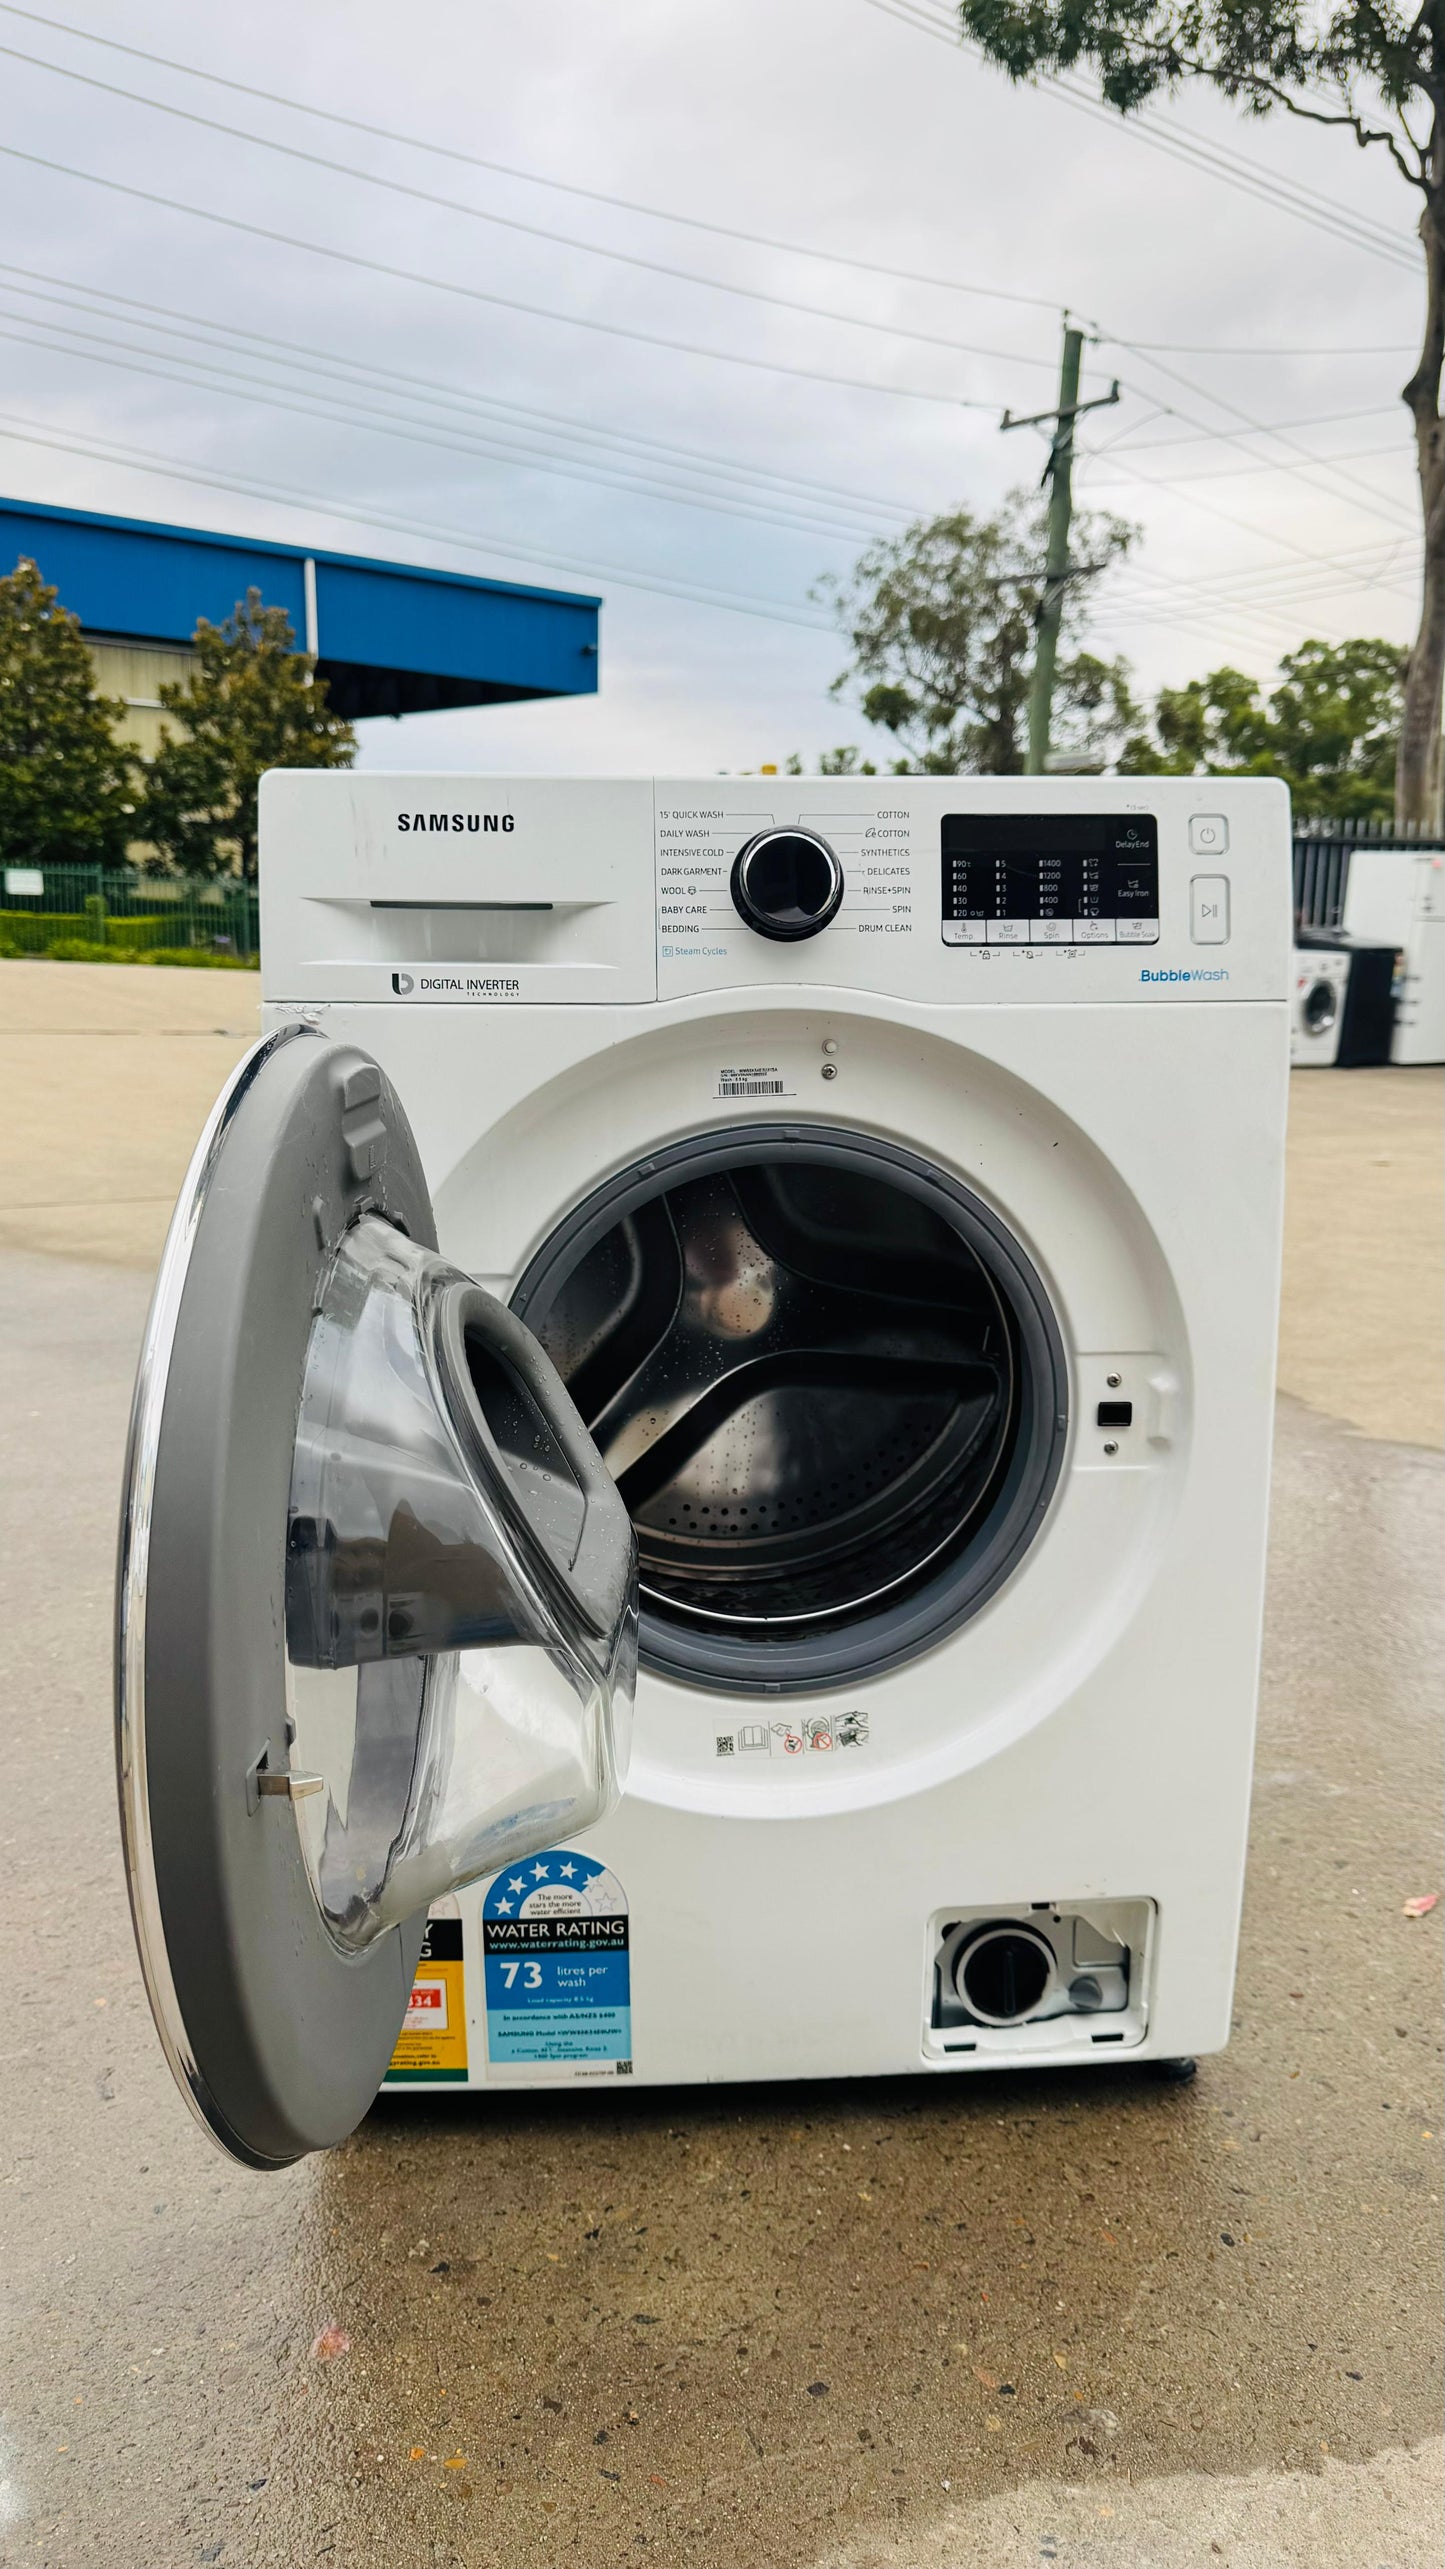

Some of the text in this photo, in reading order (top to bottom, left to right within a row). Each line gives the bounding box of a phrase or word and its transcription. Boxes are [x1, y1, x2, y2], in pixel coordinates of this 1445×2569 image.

[672, 811, 698, 819] QUICK
[699, 811, 724, 819] WASH
[877, 811, 910, 819] COTTON
[397, 813, 515, 833] SAMSUNG
[660, 829, 710, 838] DAILY WASH
[877, 829, 910, 838] COTTON
[660, 849, 724, 857] INTENSIVE COLD
[860, 849, 911, 857] SYNTHETICS
[1043, 859, 1061, 867] 1400
[661, 867, 722, 876] DARK GARMENT
[867, 867, 911, 876] DELICATES
[957, 872, 967, 880] 60
[660, 886, 687, 895] WOOL
[863, 886, 911, 895] RINSE+SPIN
[1118, 889, 1134, 898] Easy
[957, 897, 967, 905] 30
[1043, 896, 1059, 904] 400
[661, 905, 708, 914] BABY CARE
[892, 905, 912, 914] SPIN
[958, 909, 967, 917] 20
[661, 924, 700, 933] BEDDING
[858, 924, 912, 933] DRUM CLEAN
[1043, 931, 1060, 939] Spin
[1080, 931, 1109, 939] Options
[675, 946, 728, 957] Steam Cycles
[420, 978, 519, 990] DIGITAL INVERTER
[538, 1893, 551, 1901] The
[487, 1920, 625, 1938] WATER RATING
[489, 1938, 624, 1949] www.waterrating.gov.au
[500, 1961, 543, 1989] 73
[557, 1966, 608, 1977] litres per
[557, 1977, 586, 1987] wash
